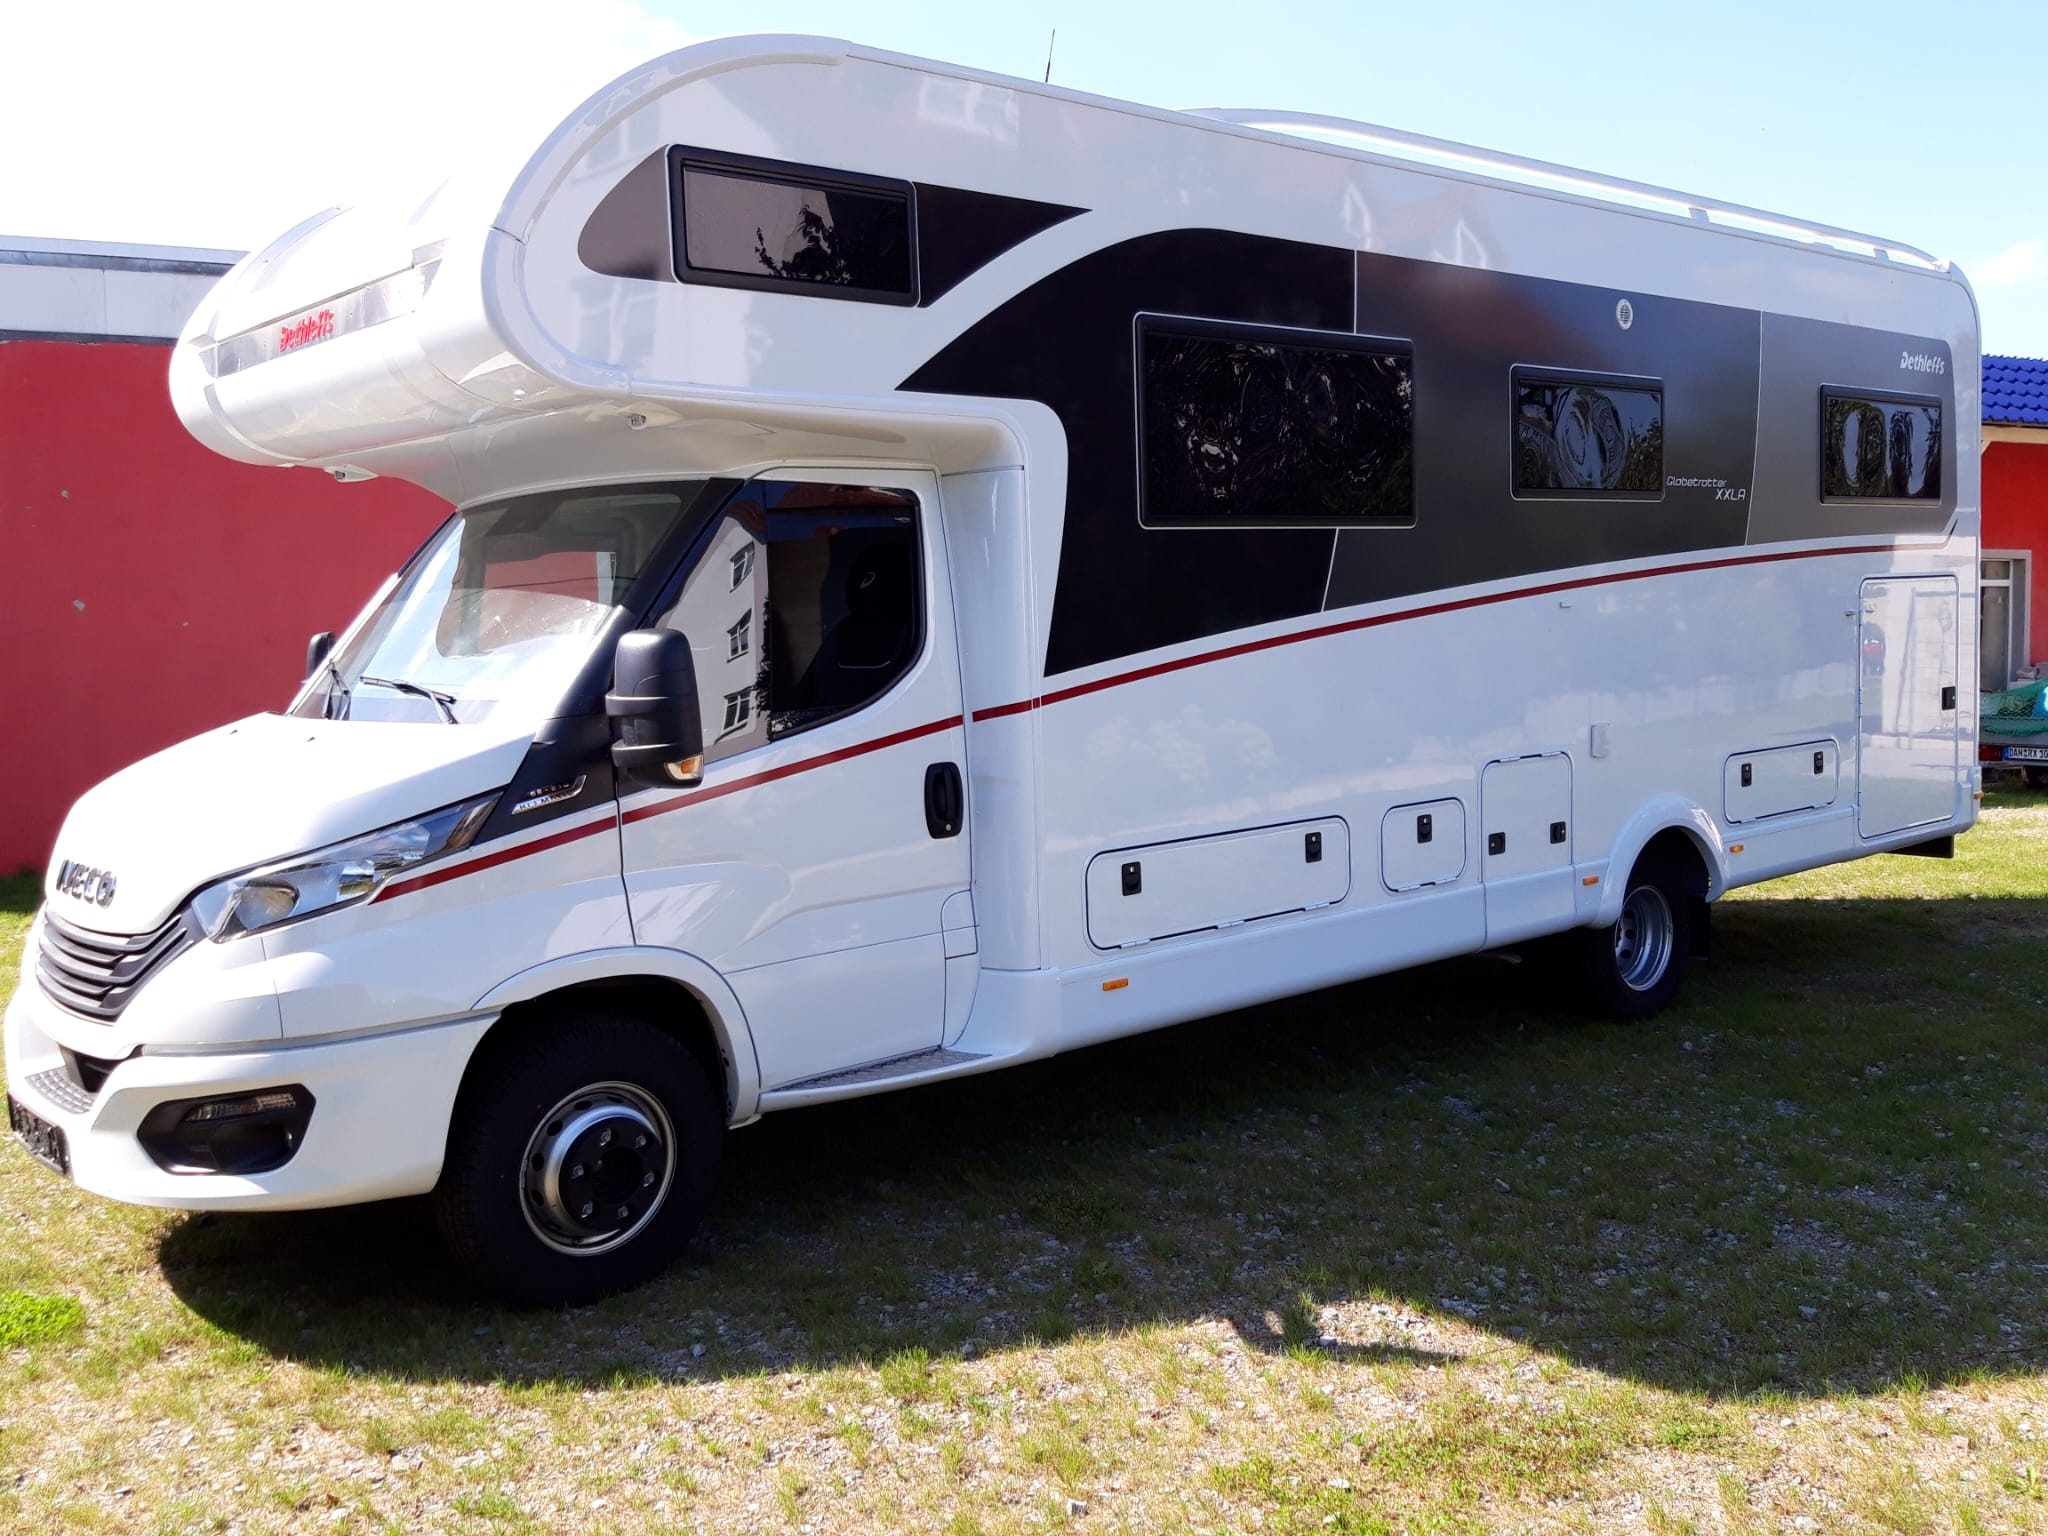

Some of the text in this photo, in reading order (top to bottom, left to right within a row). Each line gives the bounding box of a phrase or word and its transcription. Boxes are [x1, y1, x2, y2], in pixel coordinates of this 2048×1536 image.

[279, 308, 335, 352] Dethleffs
[1900, 351, 1945, 375] Dethleffs
[1666, 475, 1727, 488] Globetrotter
[1715, 488, 1746, 501] XXLA
[56, 859, 117, 909] IVECO
